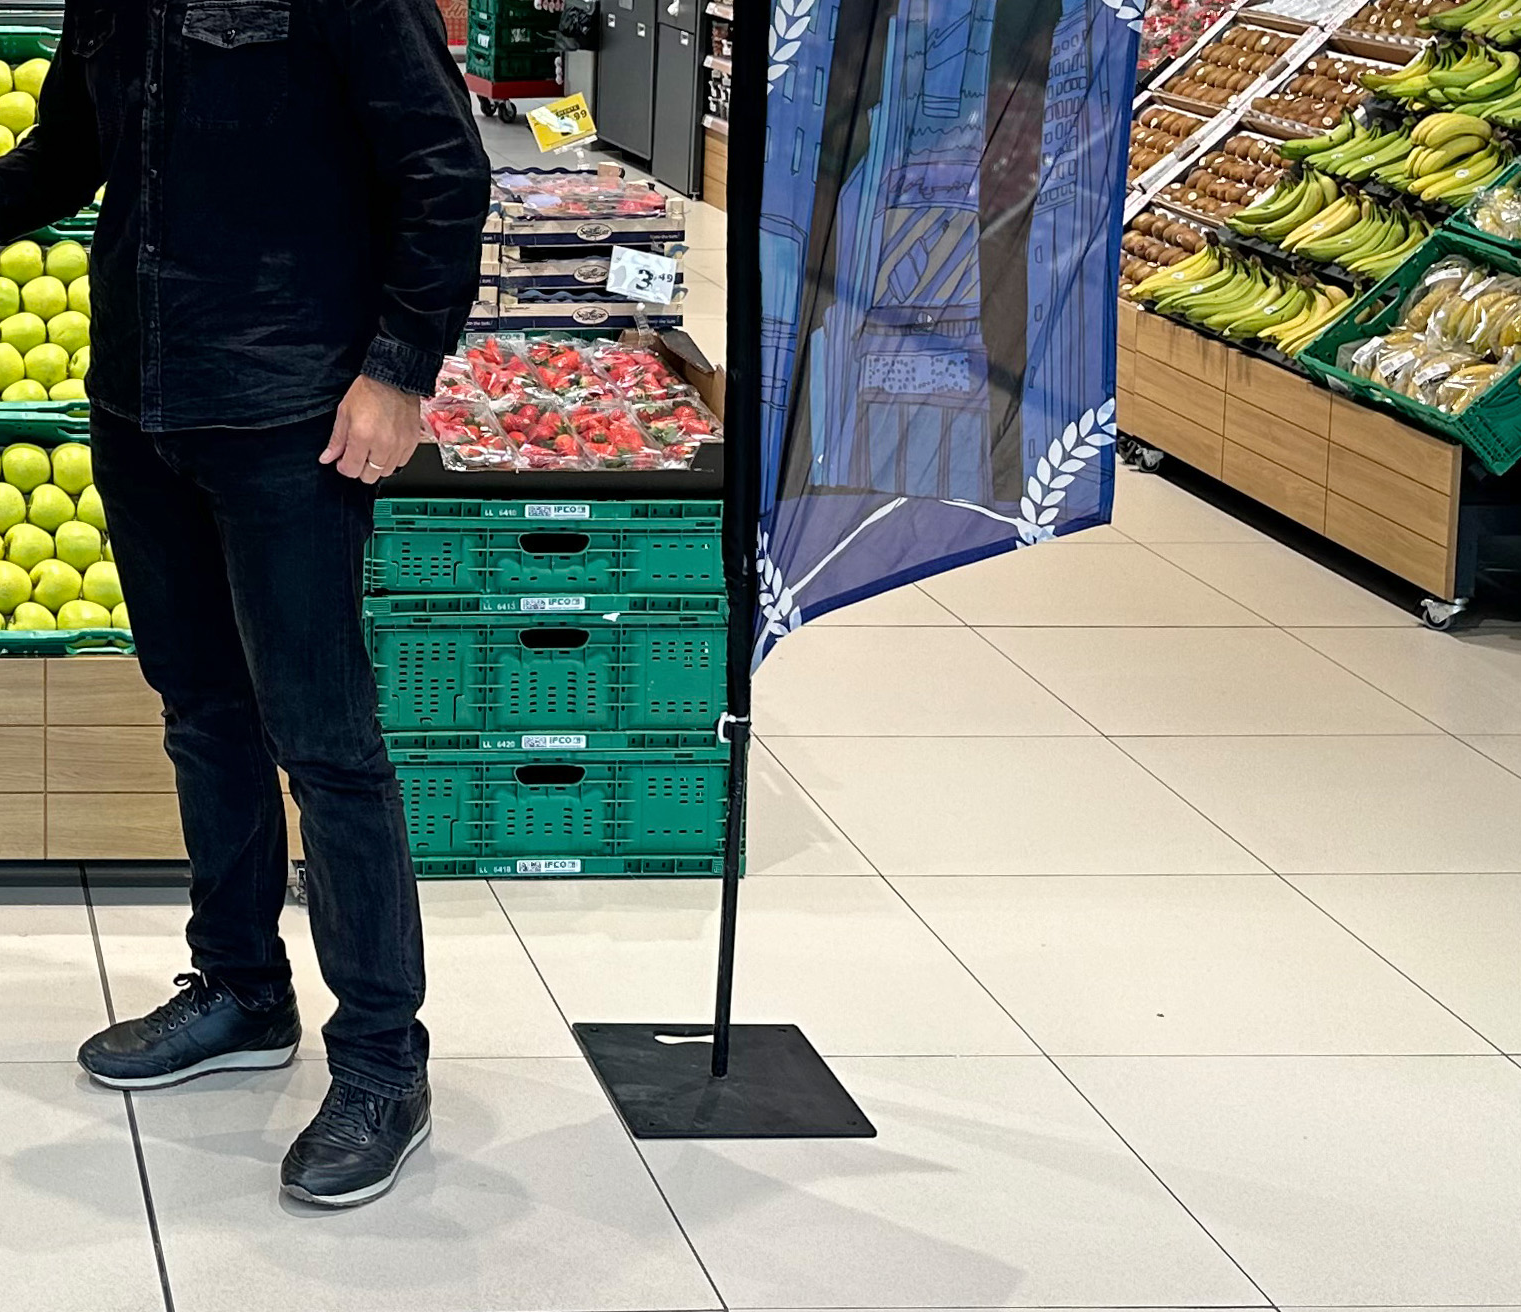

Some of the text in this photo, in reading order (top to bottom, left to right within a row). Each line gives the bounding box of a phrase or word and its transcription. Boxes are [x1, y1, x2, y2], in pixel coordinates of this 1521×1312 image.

[484, 509, 494, 517] LL
[553, 505, 577, 514] IFCO
[548, 598, 571, 606] IFCO
[483, 603, 493, 611] LL
[482, 740, 492, 748] LL
[549, 736, 572, 744] IFCO
[544, 861, 567, 869] IFCO
